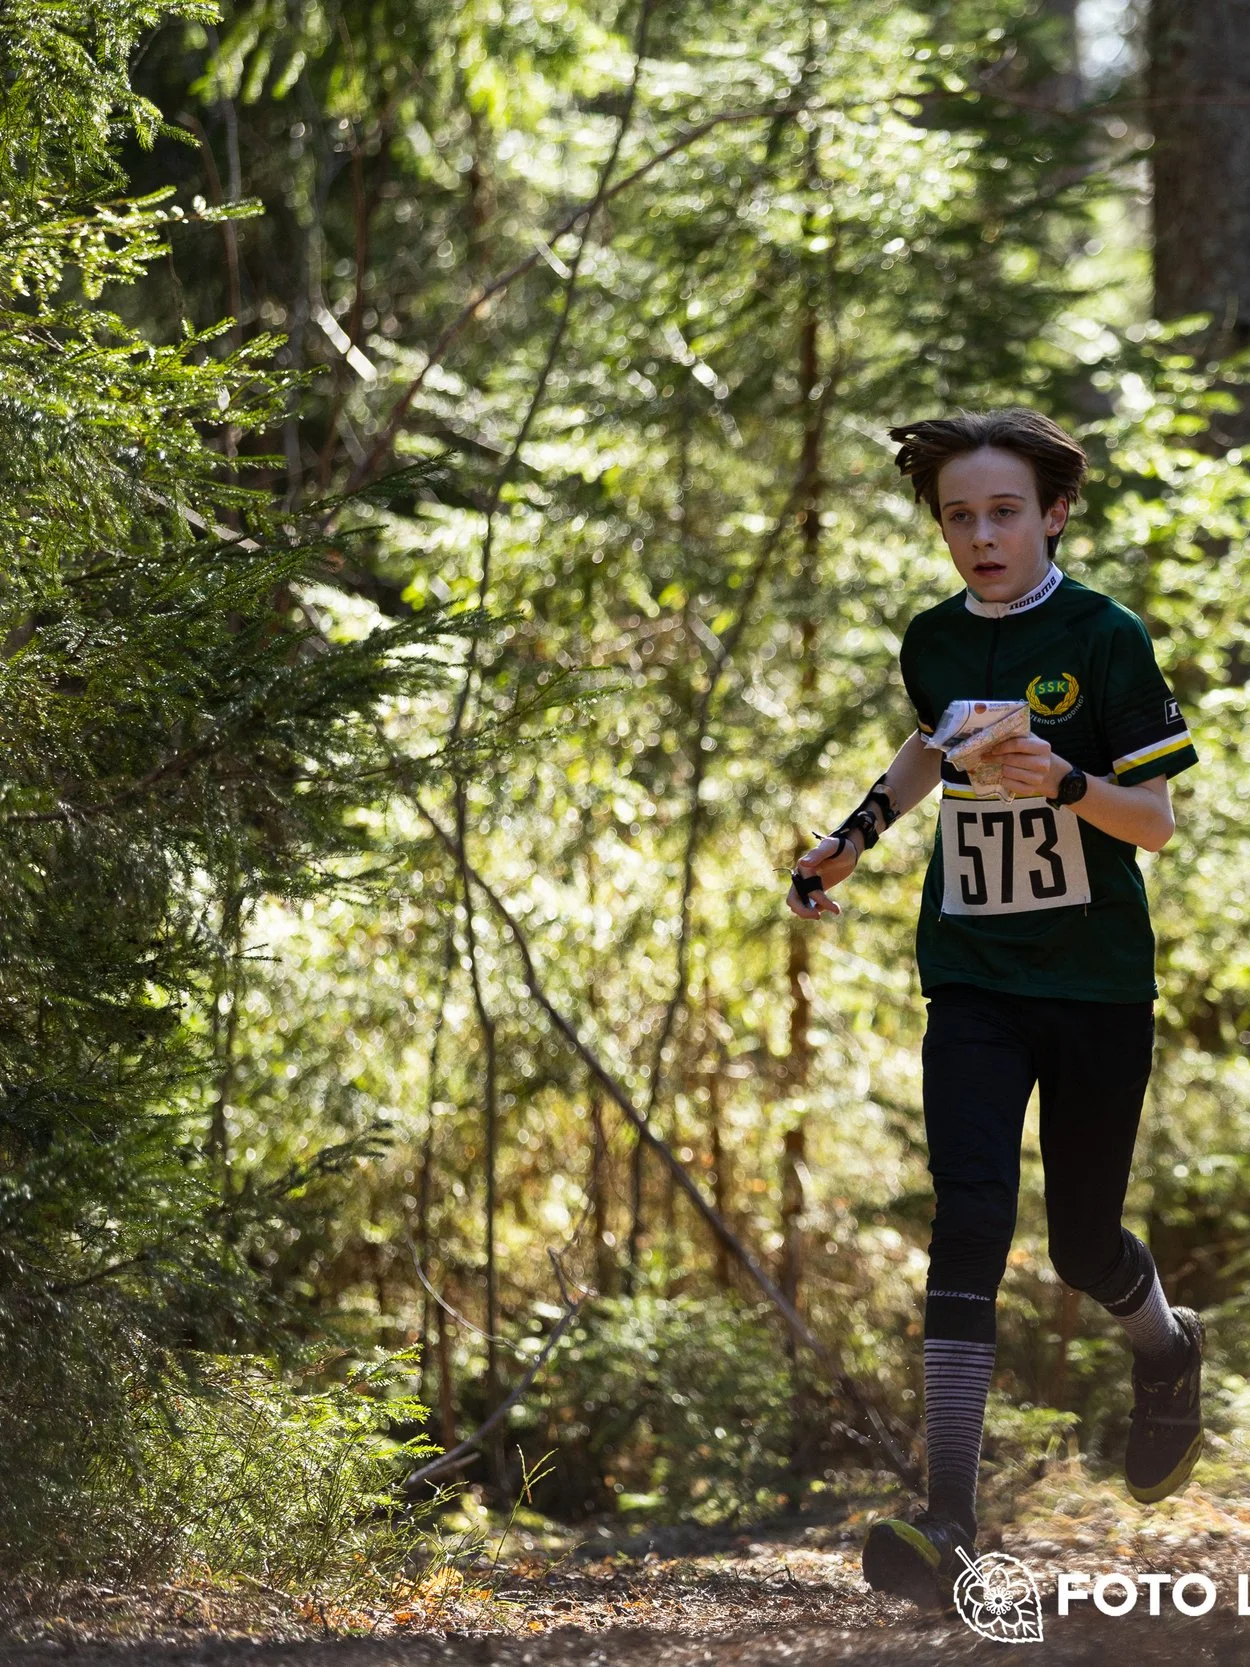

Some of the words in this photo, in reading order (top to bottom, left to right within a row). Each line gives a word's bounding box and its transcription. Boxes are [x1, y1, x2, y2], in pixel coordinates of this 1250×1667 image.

[1009, 576, 1057, 611] noname
[1038, 681, 1066, 694] SSK
[1030, 714, 1056, 726] TERING
[957, 807, 1067, 905] 573
